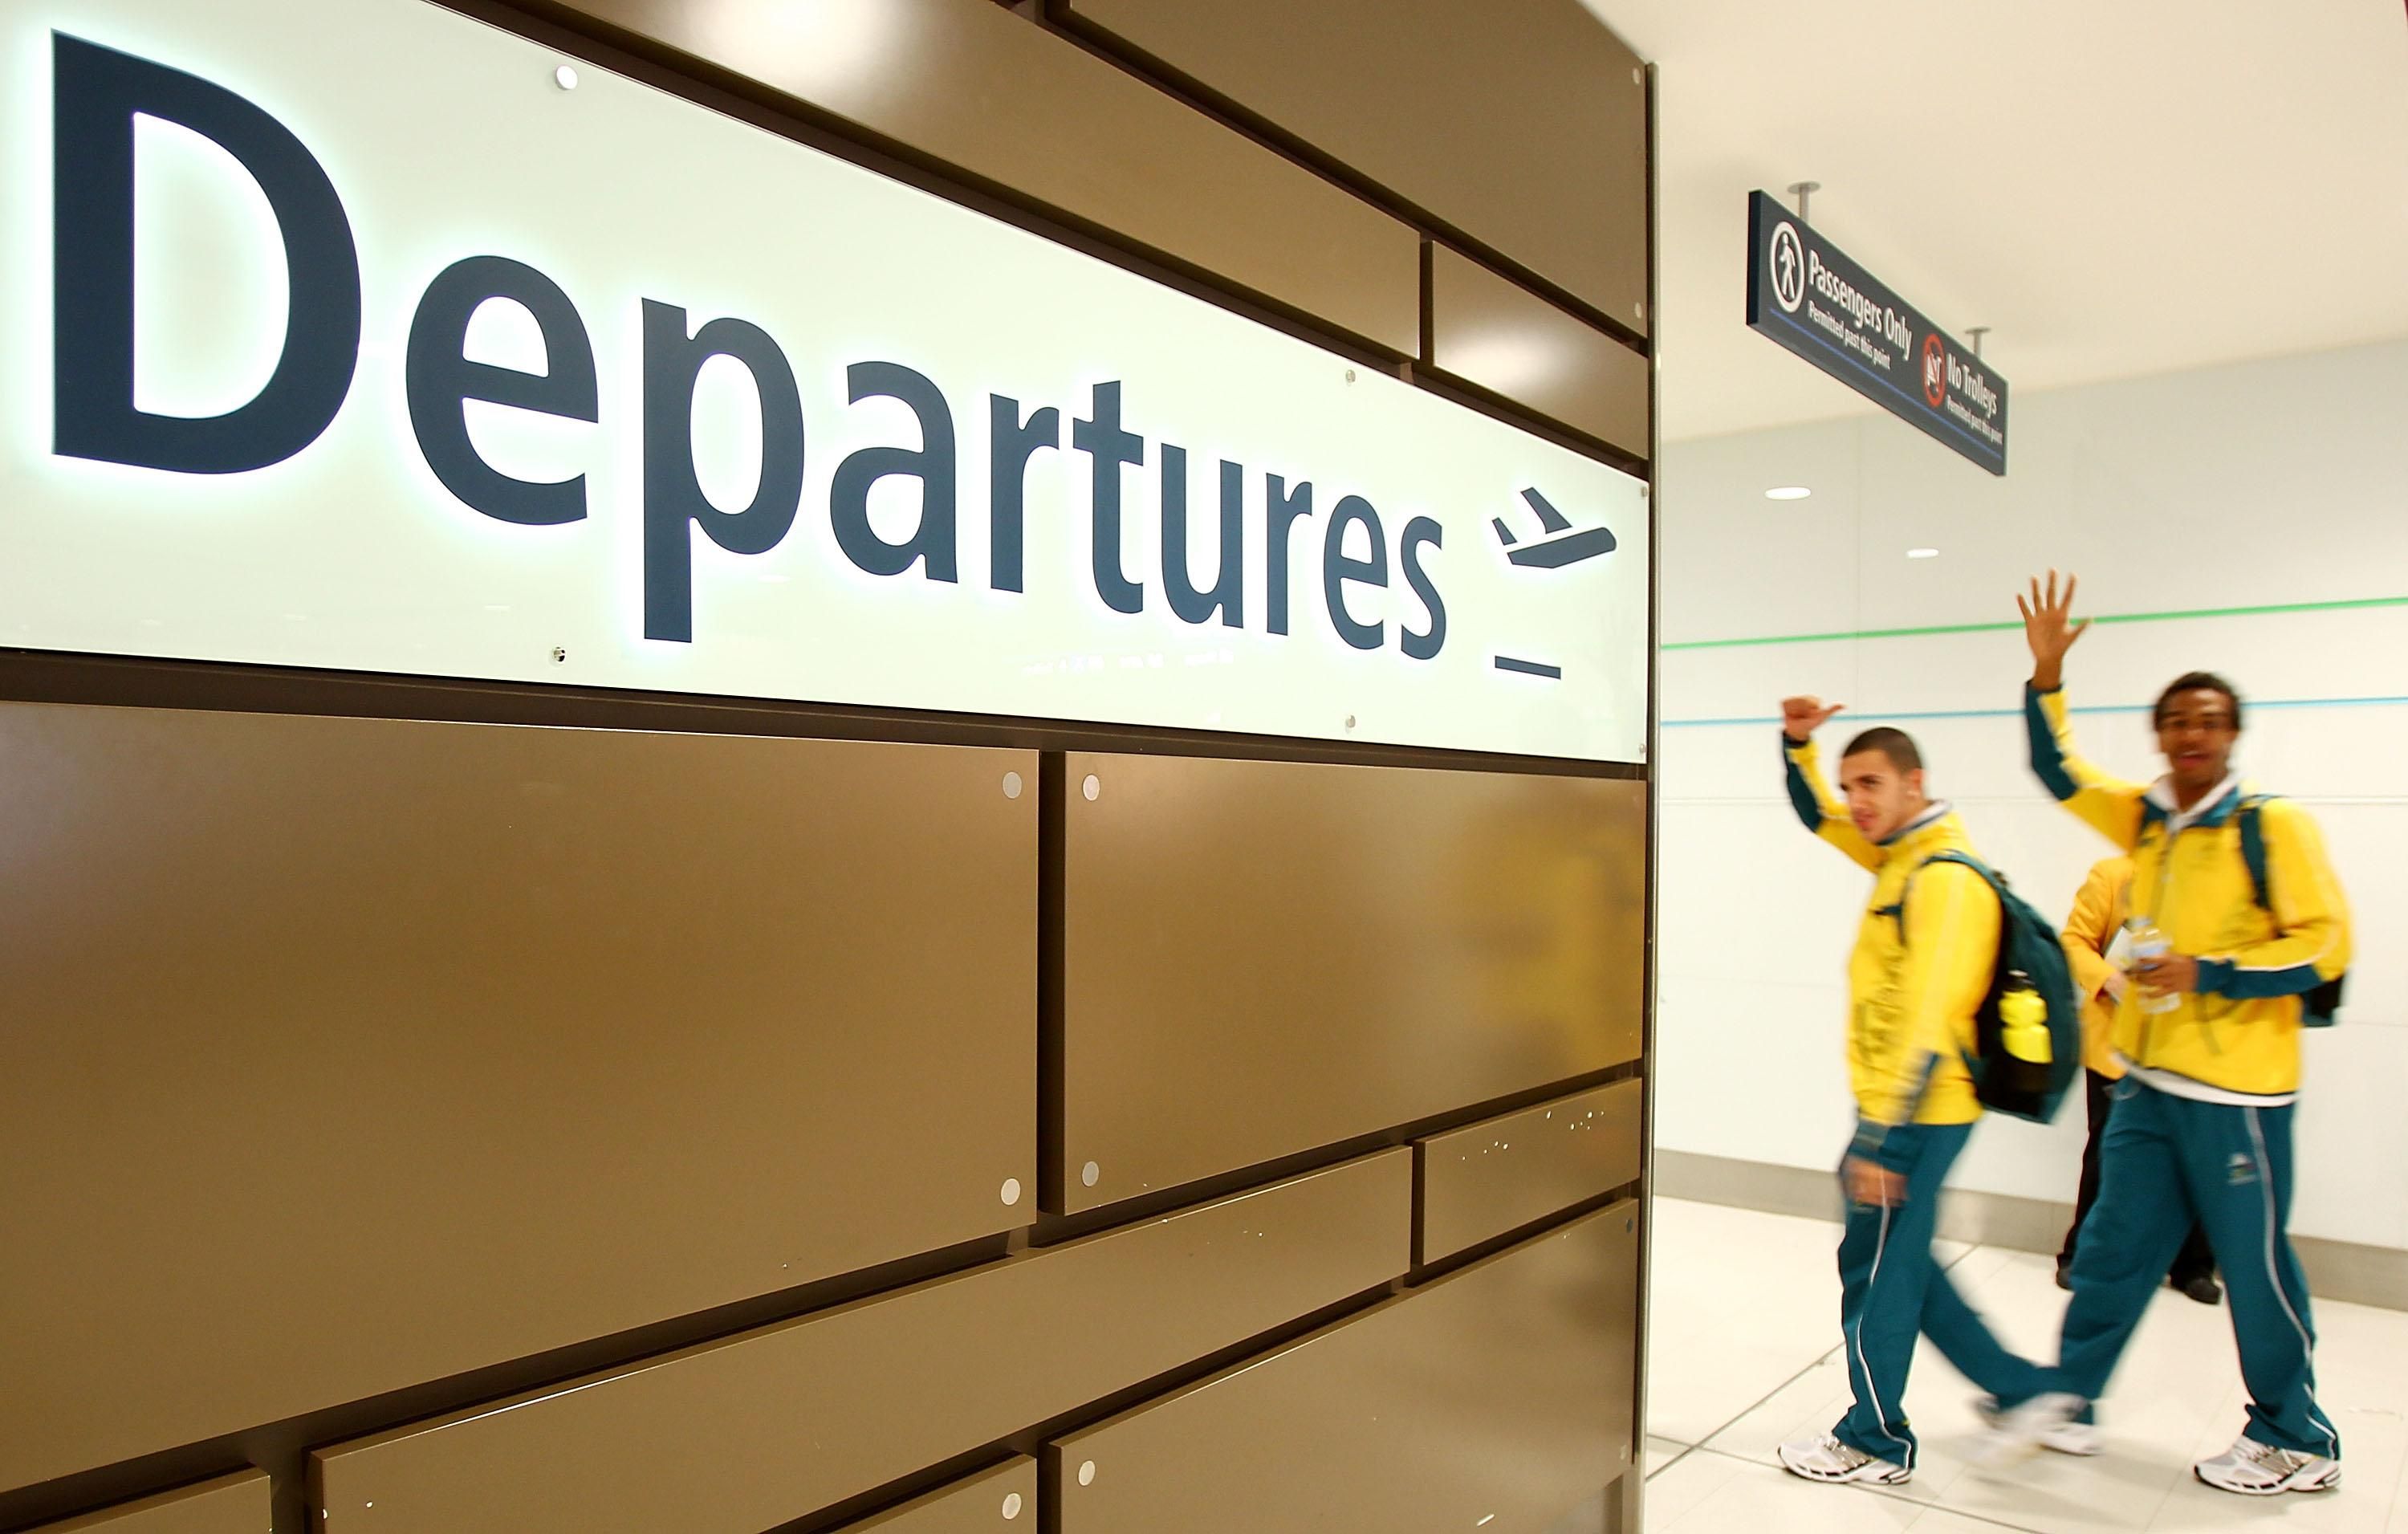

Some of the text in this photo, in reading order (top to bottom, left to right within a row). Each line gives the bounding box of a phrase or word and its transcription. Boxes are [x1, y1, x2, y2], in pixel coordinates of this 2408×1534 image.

[52, 31, 1446, 644] Departures
[1808, 249, 1913, 361] Passengers Only
[1808, 299, 1845, 340] Permitted
[1946, 352, 1963, 390] No
[1963, 364, 1998, 419] Trolleys
